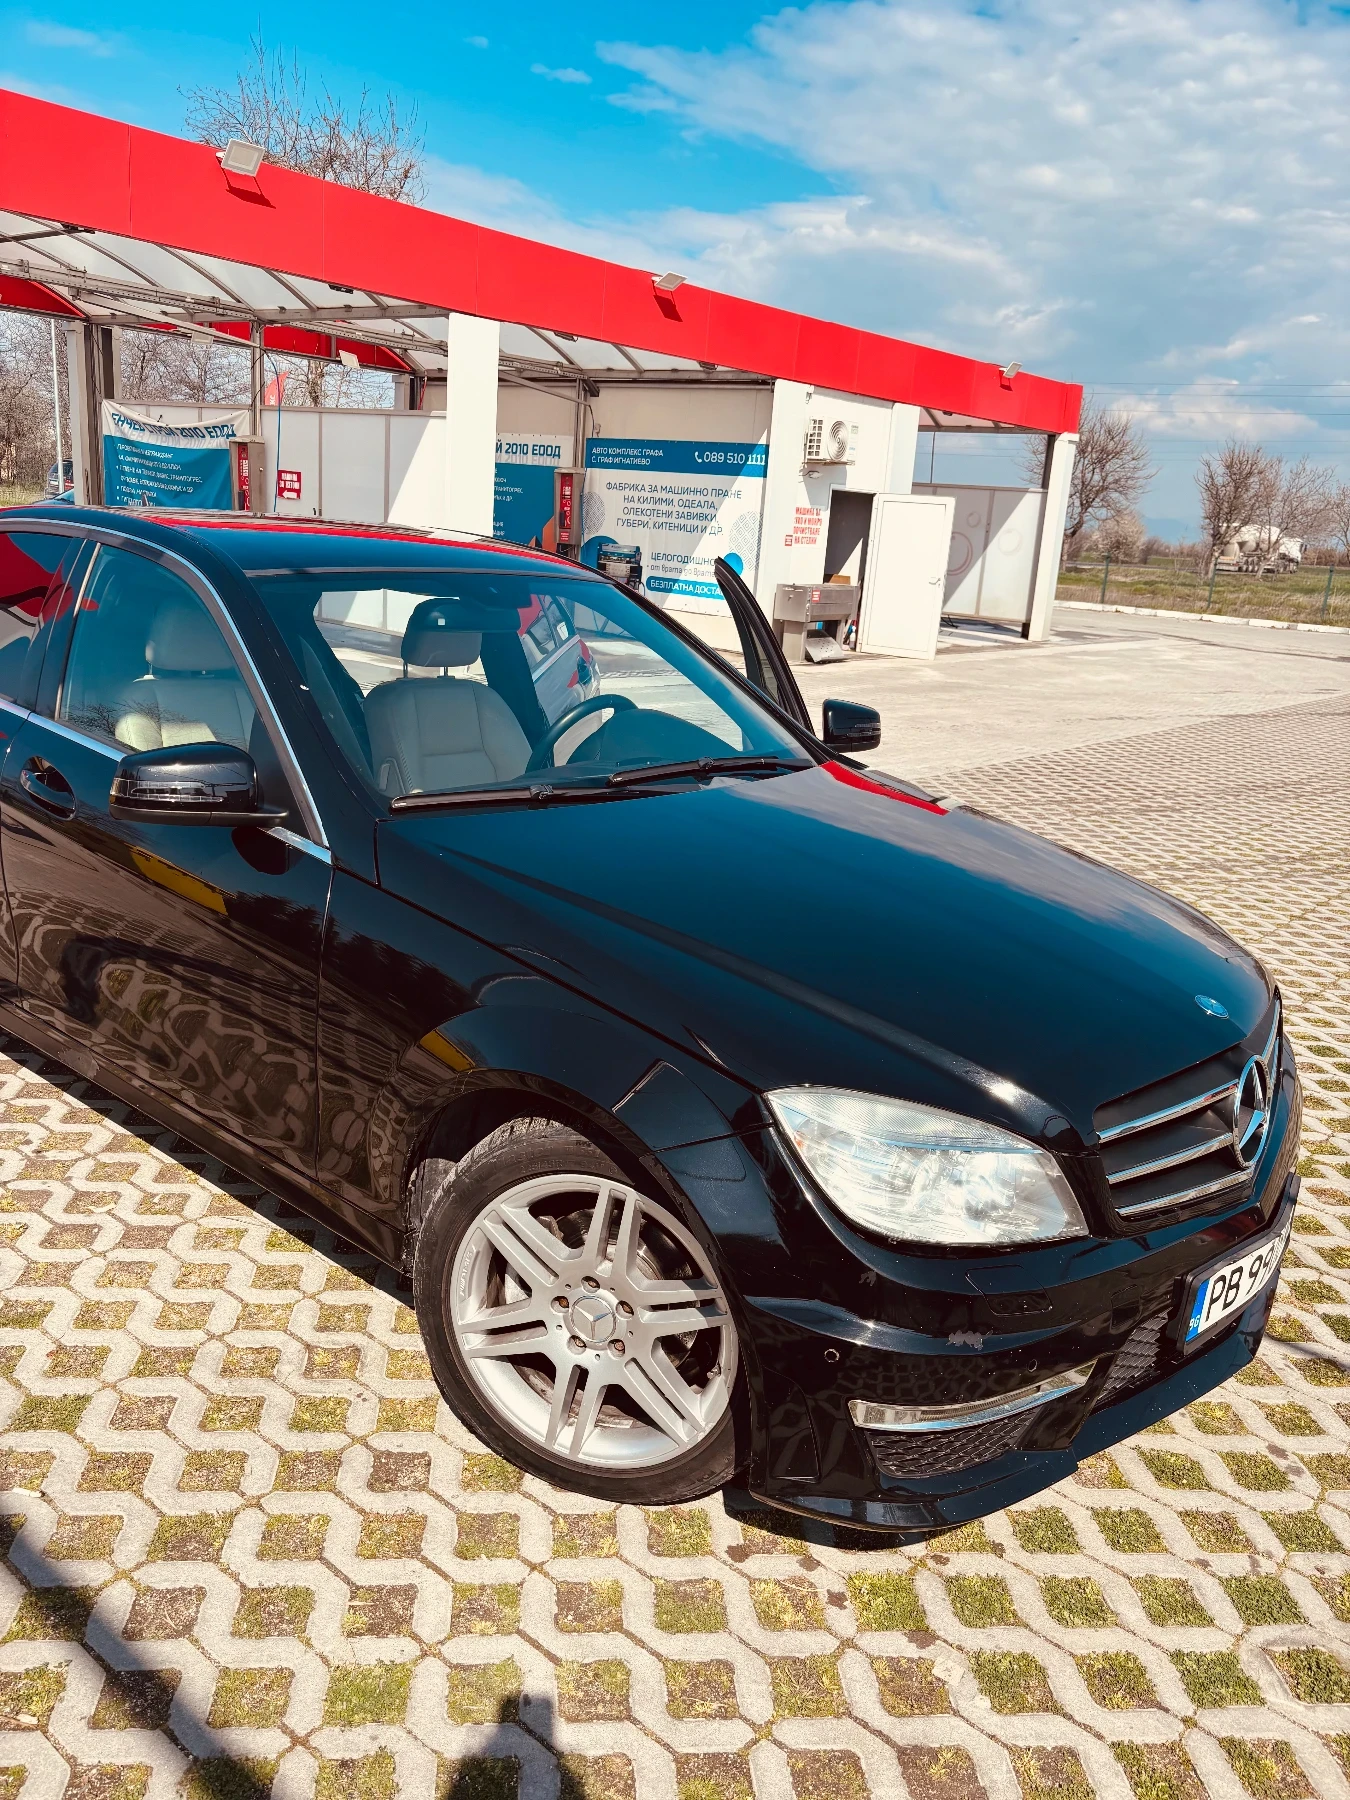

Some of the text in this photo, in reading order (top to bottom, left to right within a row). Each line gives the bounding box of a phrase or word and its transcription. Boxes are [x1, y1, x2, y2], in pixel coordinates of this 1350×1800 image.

[178, 426, 206, 439] 2010
[204, 424, 237, 439] ЕООД
[505, 443, 529, 456] 2010
[532, 444, 561, 459] ЕООД
[609, 447, 642, 456] КОМПЛЕКС
[643, 448, 664, 456] ГРАФА
[704, 451, 766, 465] 089 510 1111
[614, 457, 651, 465] ИГНАТИЕВО
[605, 481, 742, 499] ФАБРИКА ЗА МАШИННО ПРАНЕ
[623, 495, 718, 511] НА КИЛИМИ, ОДЕАЛА,
[622, 506, 673, 519] ОЛЕКОТЕНИ
[616, 517, 724, 536] ГУБЕРИ, КИТЕНИЦИ И ДР.
[650, 579, 723, 595] БЕЗПЛАТНА ДОСТА
[1205, 1266, 1244, 1323] PB
